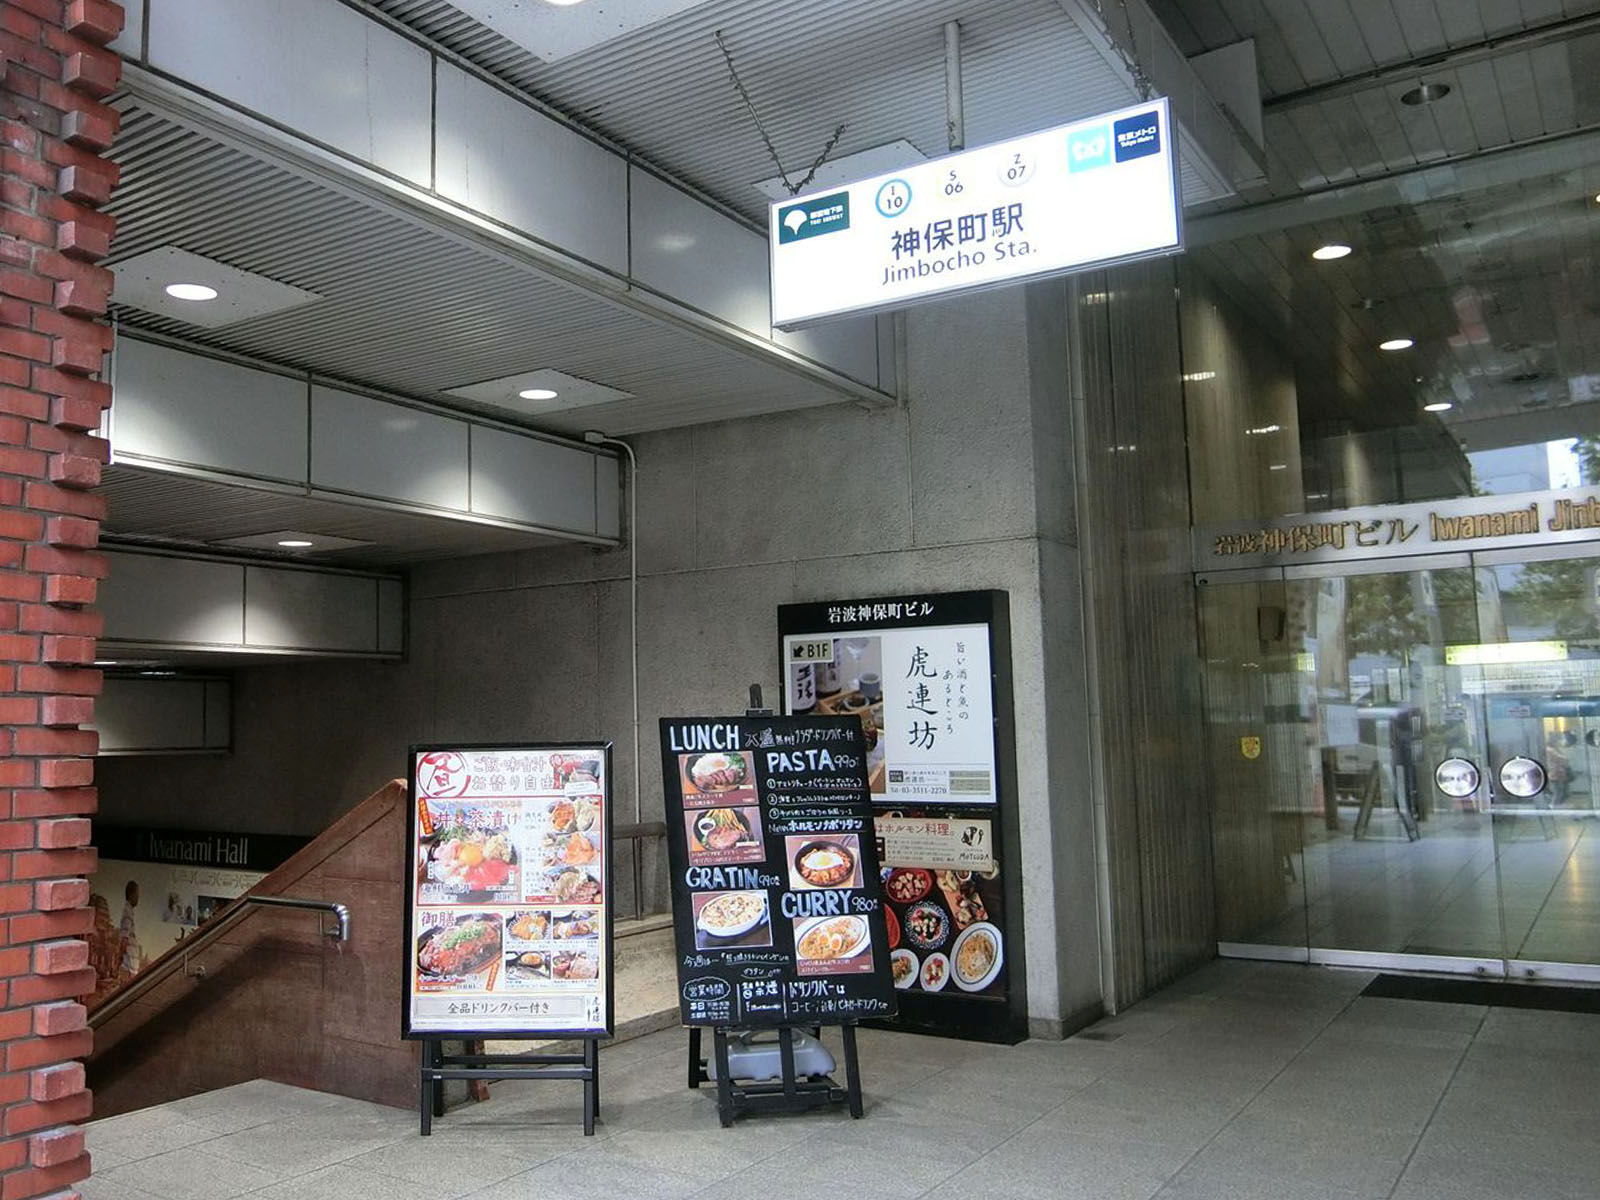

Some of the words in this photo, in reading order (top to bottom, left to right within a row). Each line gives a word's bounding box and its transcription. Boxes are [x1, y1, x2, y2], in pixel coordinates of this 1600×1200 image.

[1014, 153, 1022, 165] Z
[949, 170, 957, 182] S
[1007, 165, 1026, 180] 07
[890, 185, 896, 196] I
[944, 182, 964, 196] 06
[886, 196, 903, 209] 10
[891, 202, 1024, 261] 神保町駅
[882, 250, 986, 286] Jimbocho
[994, 240, 1038, 262] Sta.
[1429, 502, 1540, 542] Iwanami
[1213, 518, 1420, 556] 岩波神保町ビル
[828, 601, 934, 624] 岩波神保町ビル
[807, 643, 828, 658] B1F
[905, 645, 938, 751] 虎連坊
[942, 669, 954, 735] あるところ
[670, 725, 740, 751] LUNCH
[766, 749, 836, 774] PASTA
[150, 832, 212, 862] Iwanami
[216, 837, 248, 865] Hall
[685, 866, 759, 889] GRATIN
[781, 890, 852, 918] CURRY
[447, 1001, 550, 1015] 全品ドリンクバー付き
